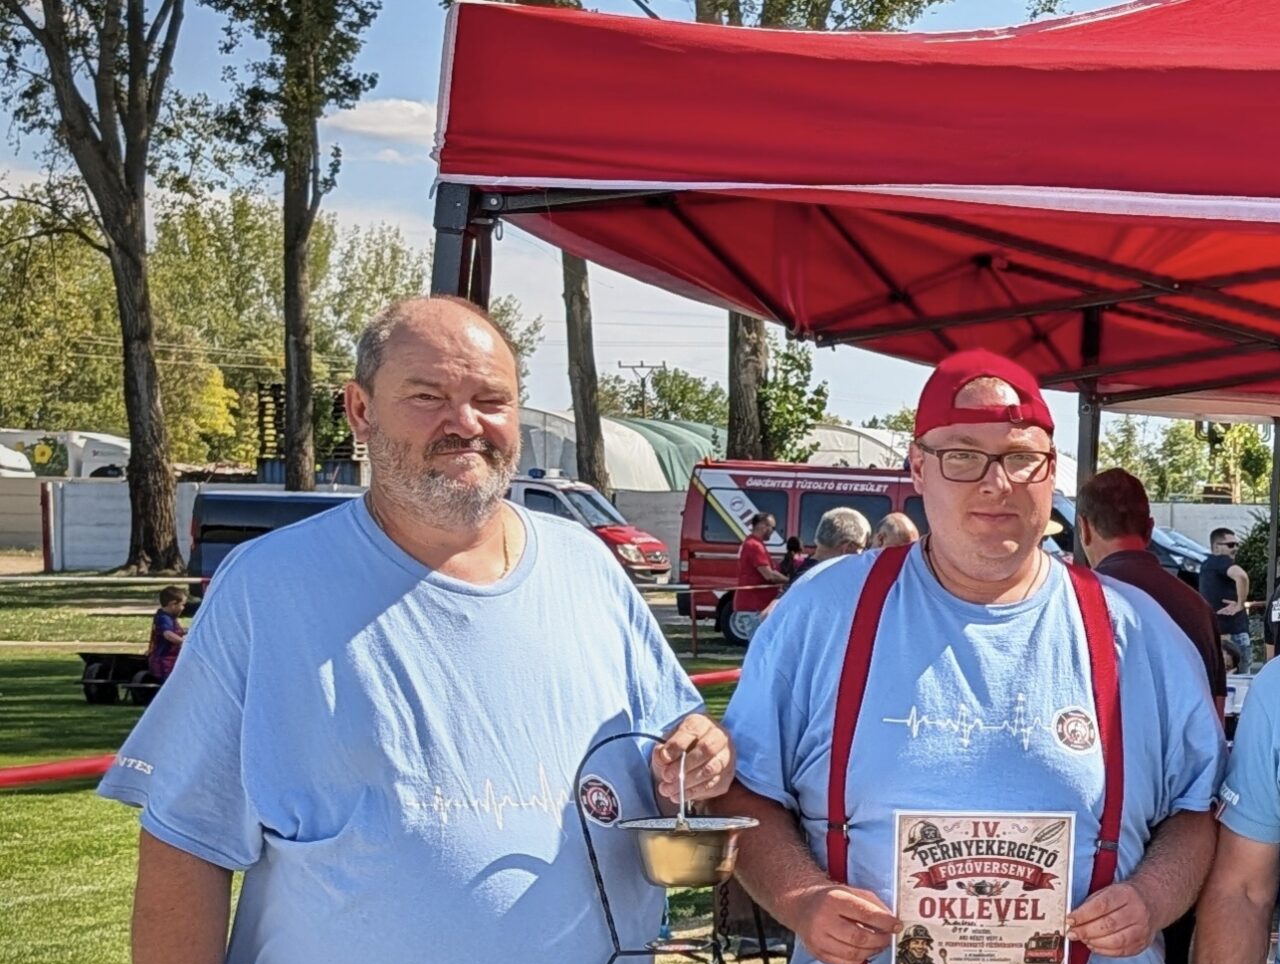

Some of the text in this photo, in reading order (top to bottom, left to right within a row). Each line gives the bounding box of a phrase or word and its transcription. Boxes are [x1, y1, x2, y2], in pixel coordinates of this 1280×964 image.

[746, 477, 794, 488] ÖNKÉNTES
[836, 482, 889, 493] EGYESÜLET
[971, 821, 1000, 838] IV.
[918, 839, 1060, 868] PERNYEKERGETŐ
[938, 860, 1035, 879] FŐZŐVERSENY
[919, 894, 1046, 920] OKLEVÉL
